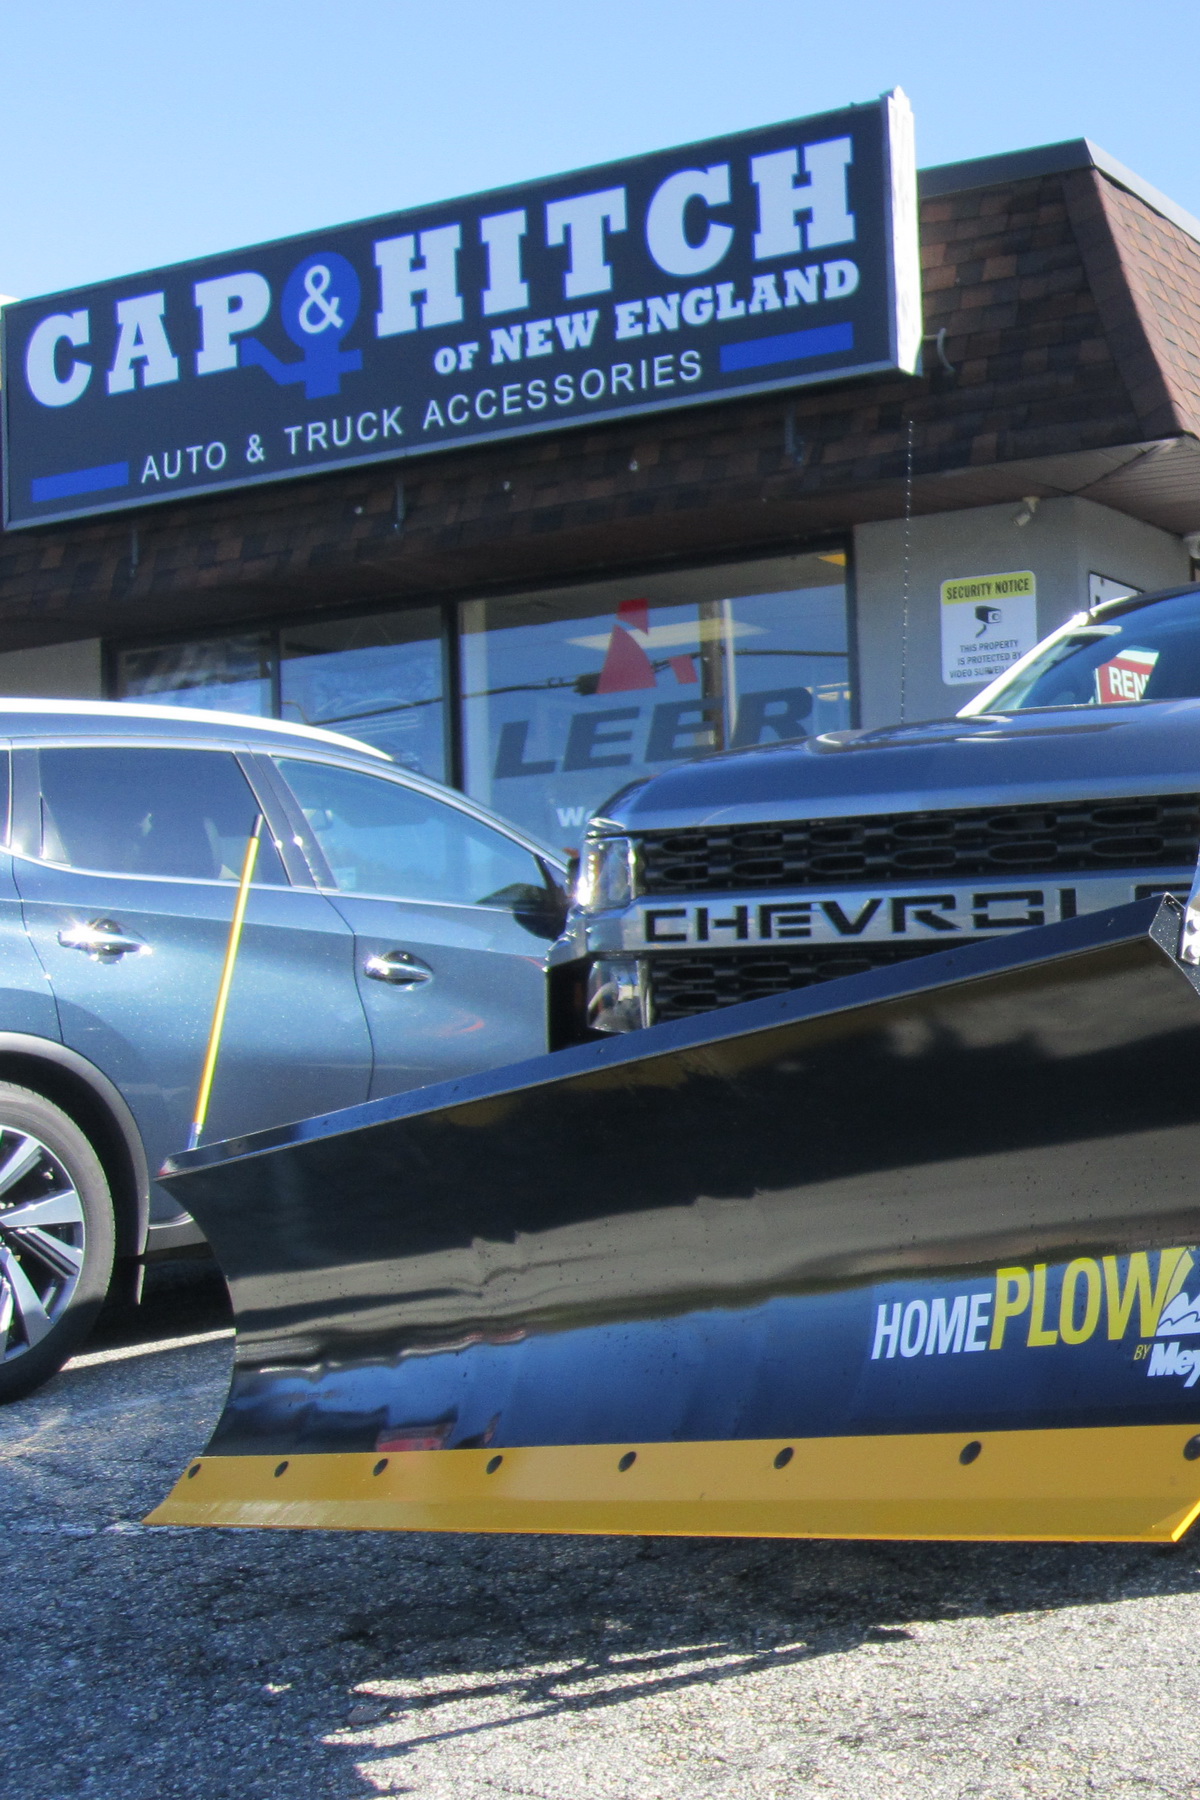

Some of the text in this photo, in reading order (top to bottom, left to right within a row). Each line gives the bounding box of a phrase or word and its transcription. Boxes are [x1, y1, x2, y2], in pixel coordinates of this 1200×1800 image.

[26, 135, 857, 408] CAP & HITCH
[433, 259, 860, 375] OF NEW ENGLAND
[141, 350, 703, 484] AUTO & TRUCK ACCESSORIES
[946, 578, 1030, 600] SECURITY NOTICE
[960, 640, 1018, 653] THIS PROPERTY
[957, 650, 1022, 666] IS PROTECTED BY
[949, 668, 972, 679] VIDEO
[495, 686, 813, 779] LEER
[1133, 1344, 1152, 1360] BY
